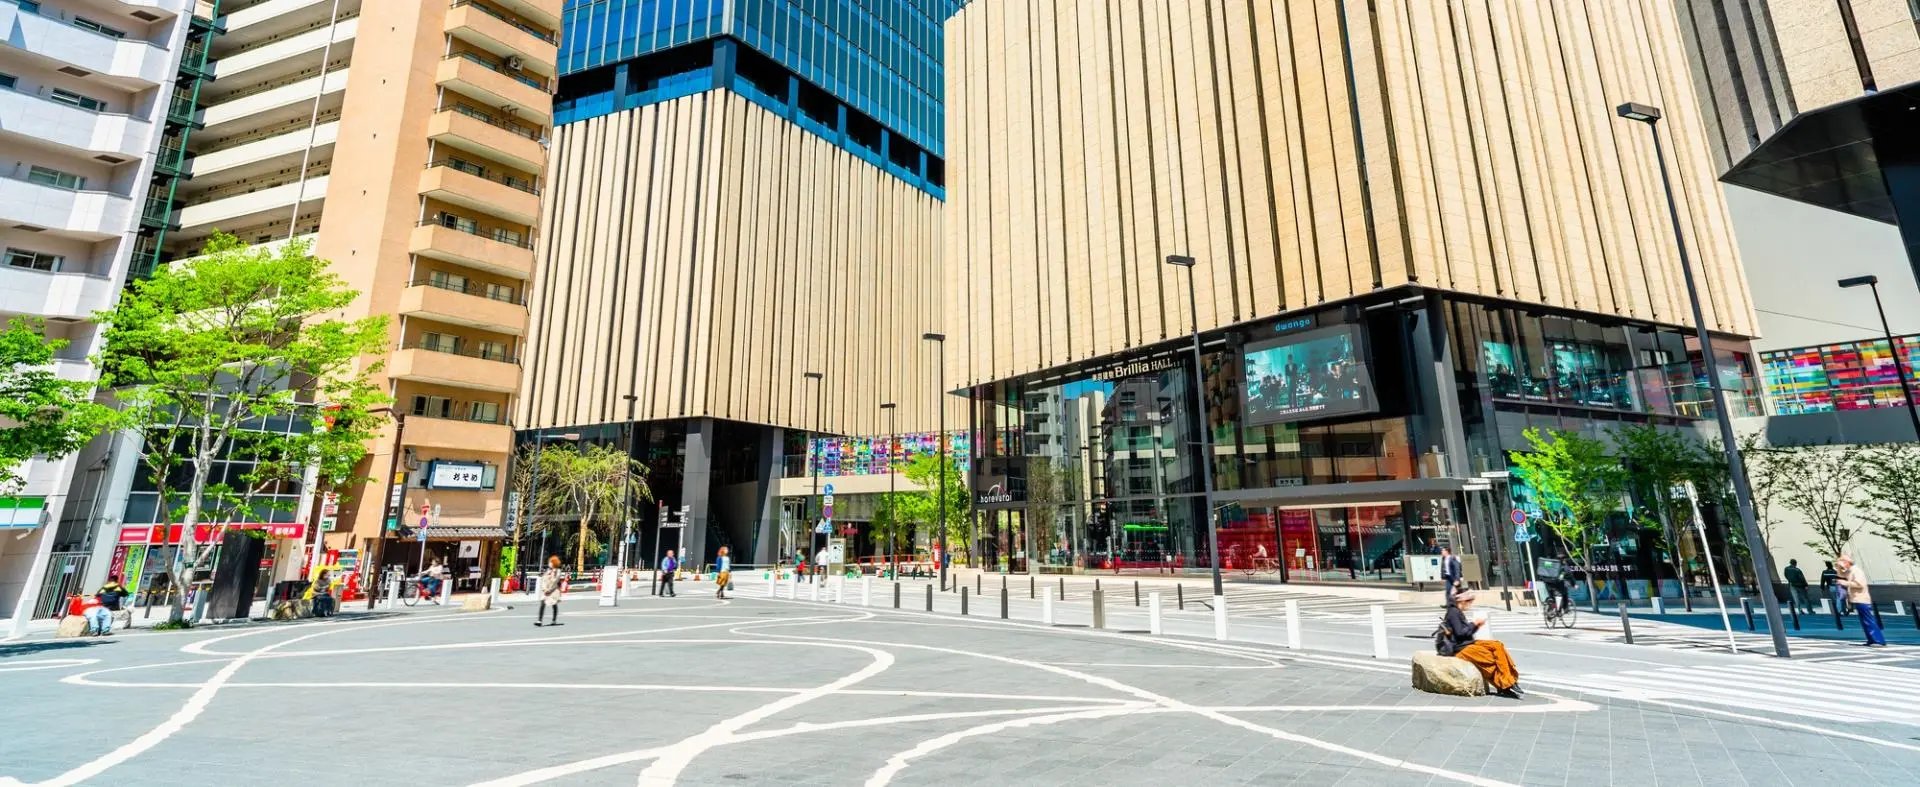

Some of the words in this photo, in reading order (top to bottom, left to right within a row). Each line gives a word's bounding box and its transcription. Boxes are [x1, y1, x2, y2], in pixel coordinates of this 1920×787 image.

[1275, 319, 1311, 331] dwango
[1114, 362, 1149, 378] Brillia
[1151, 358, 1172, 370] HALL
[453, 472, 477, 481] おそめ
